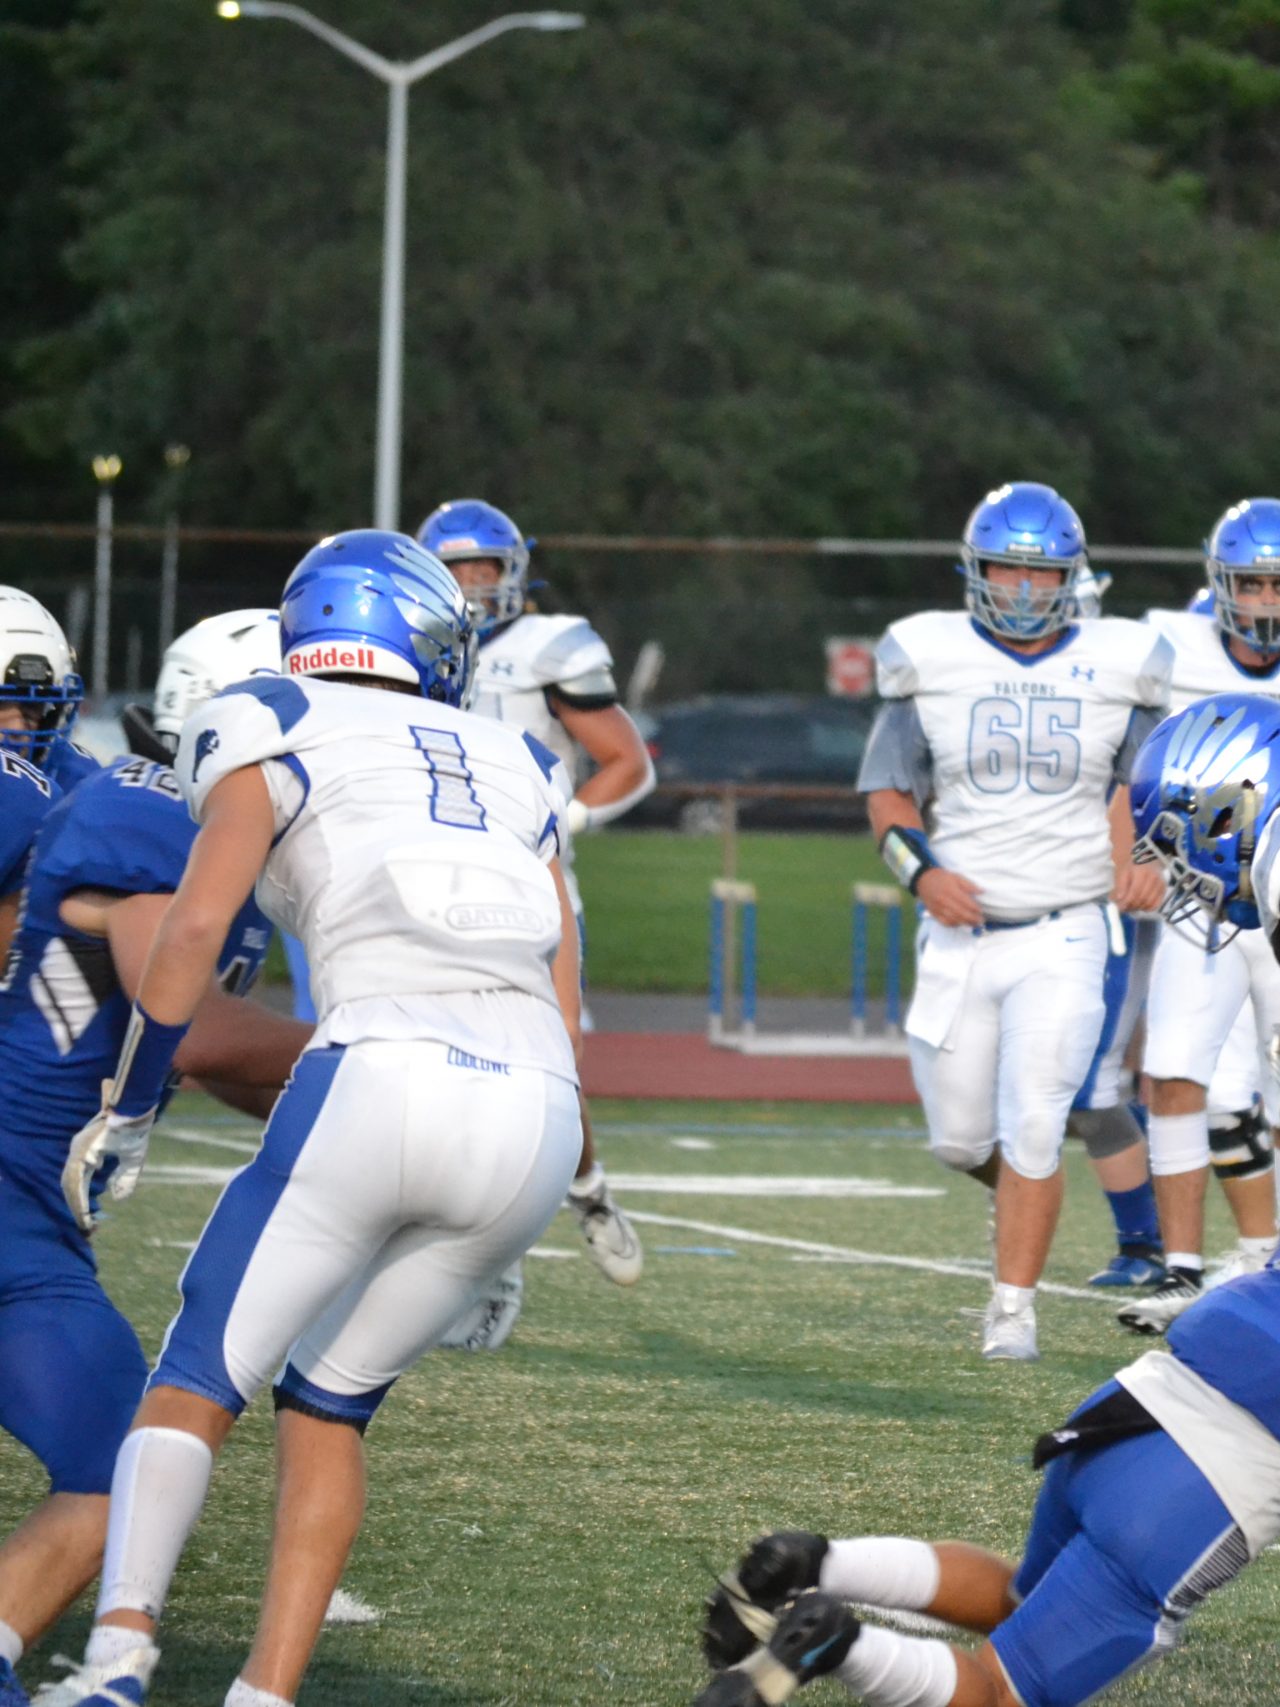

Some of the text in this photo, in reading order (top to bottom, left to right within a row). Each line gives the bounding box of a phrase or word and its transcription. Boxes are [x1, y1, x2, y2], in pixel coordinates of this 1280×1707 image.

[289, 647, 375, 675] Riddell
[994, 682, 1057, 697] FALCONS
[967, 696, 1082, 795] 65
[408, 725, 488, 831] 1
